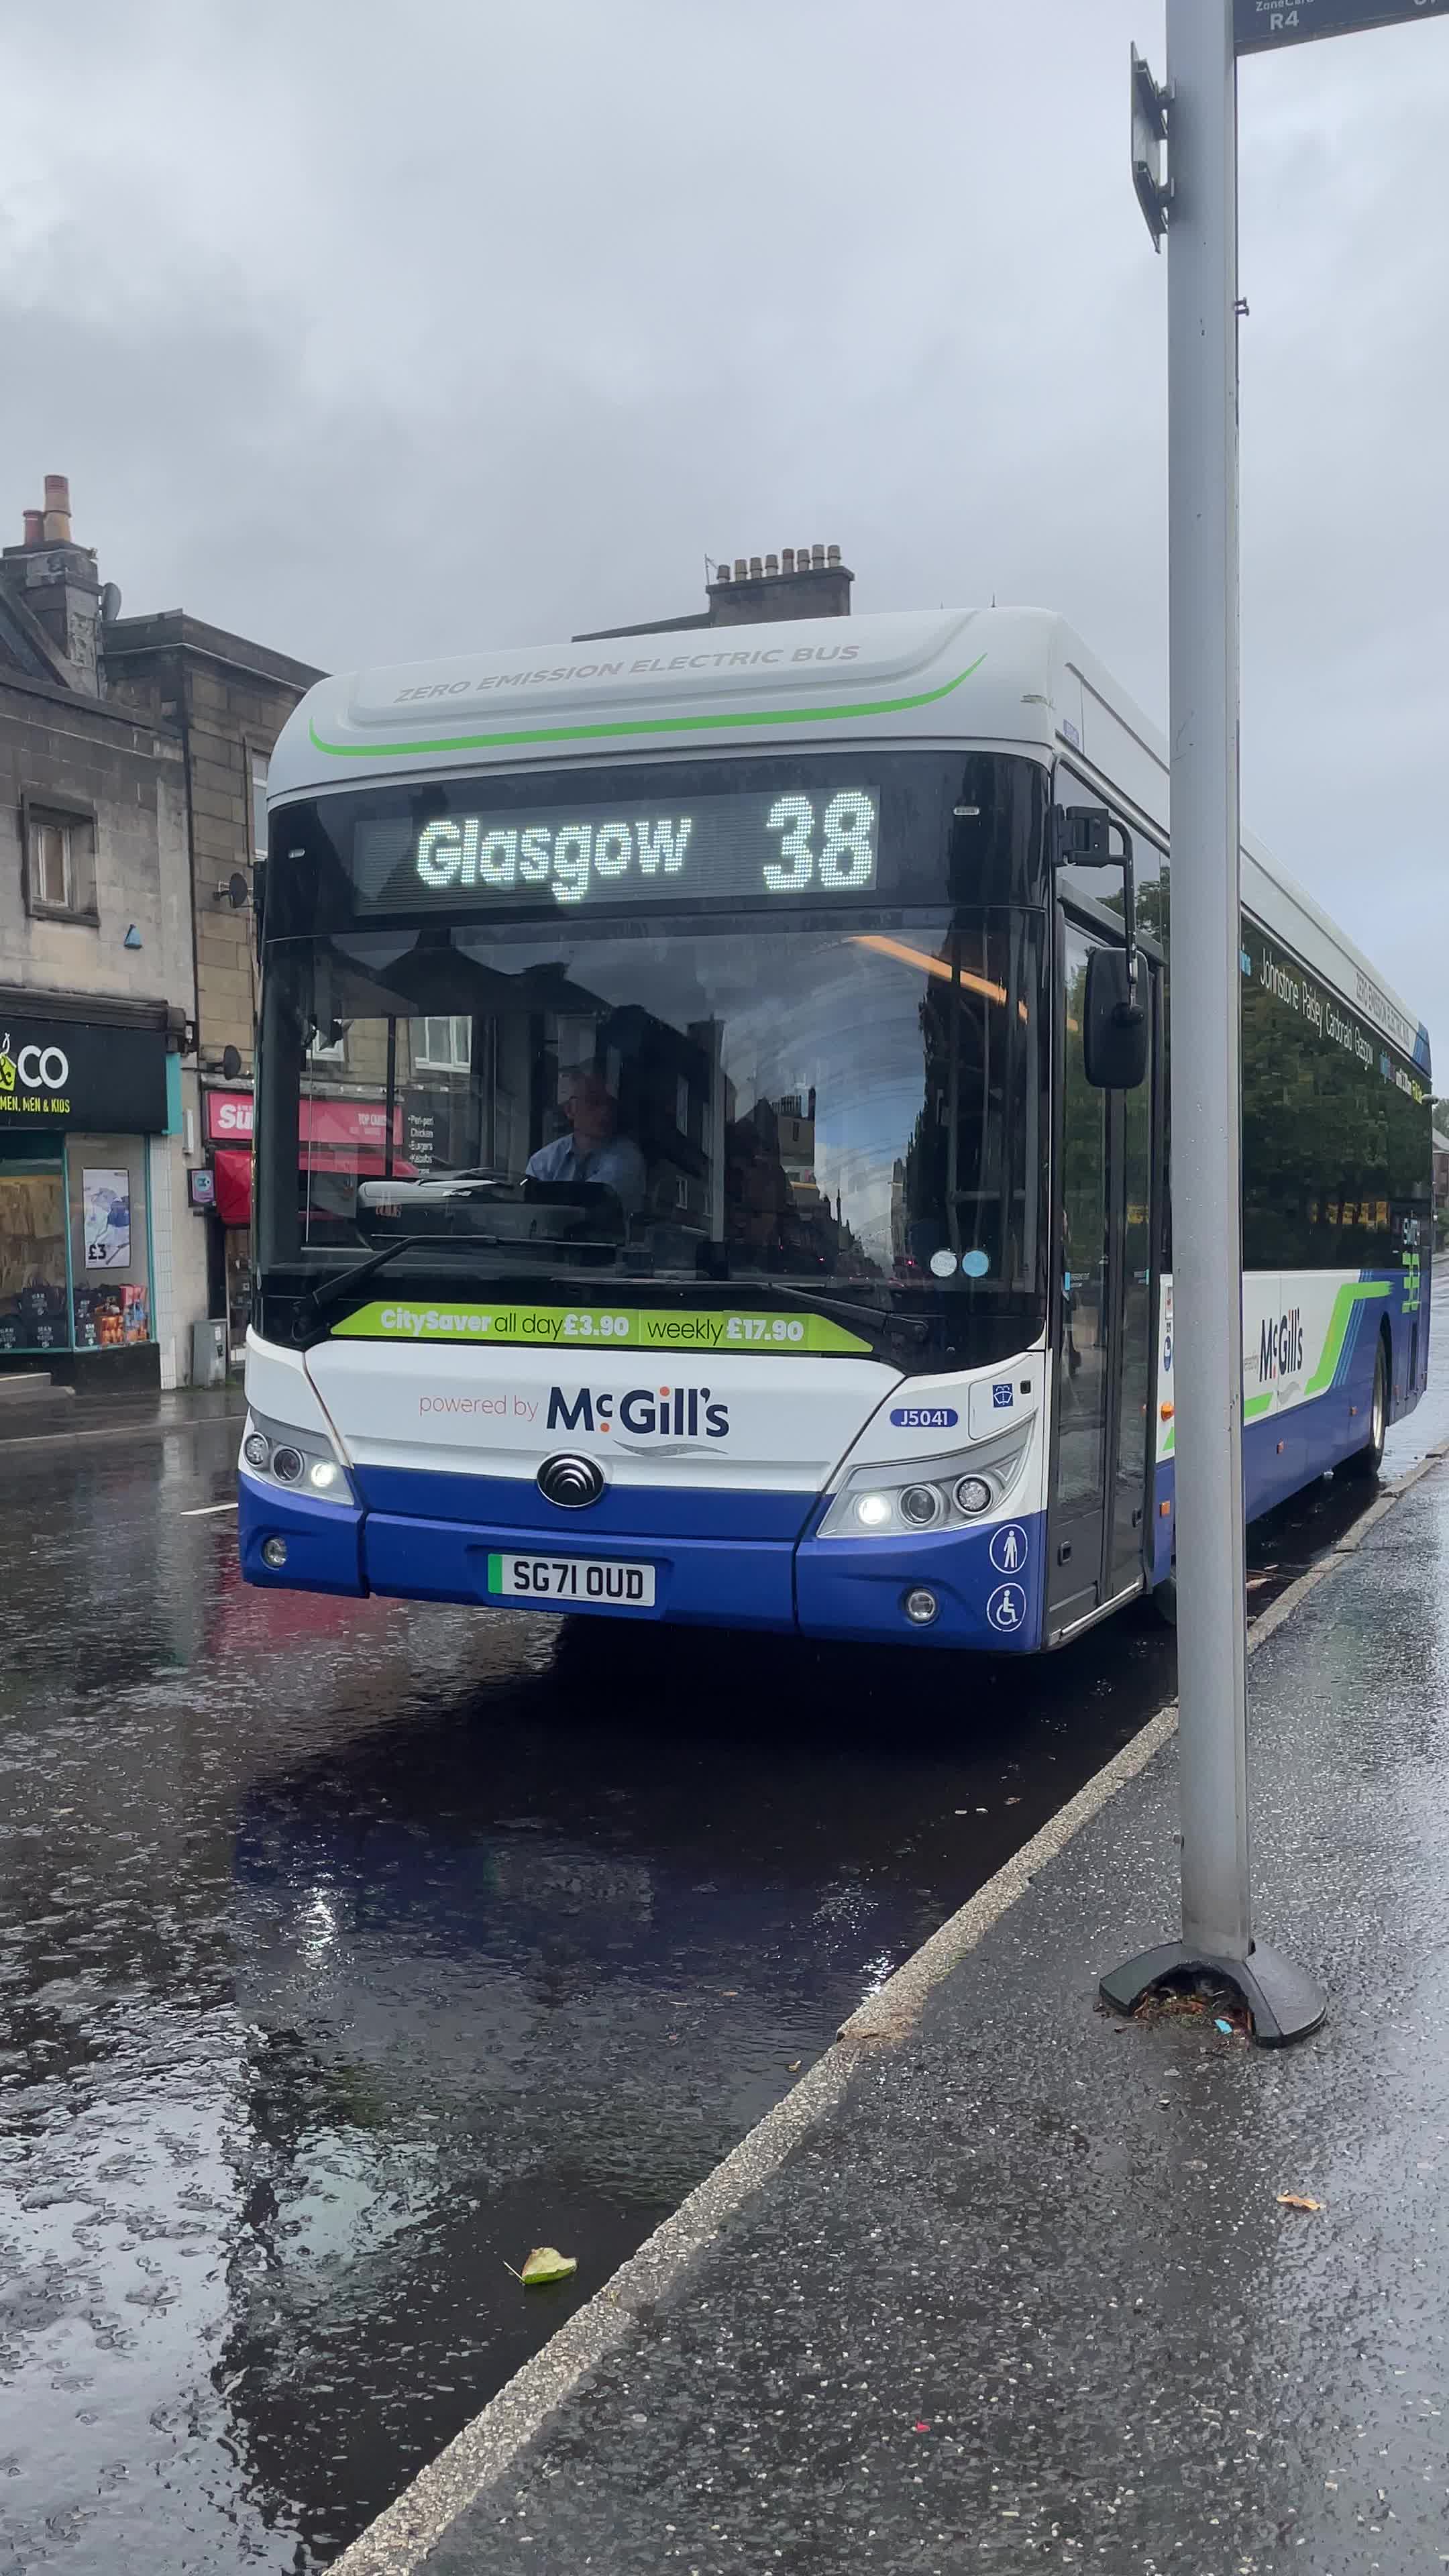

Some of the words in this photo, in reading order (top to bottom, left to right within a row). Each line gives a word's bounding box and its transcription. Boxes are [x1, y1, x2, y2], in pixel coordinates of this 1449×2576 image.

[1255, 0, 1312, 11] ZoneCar
[1270, 11, 1299, 30] R4
[394, 682, 471, 704] ZERO
[476, 661, 622, 692] EMISSION
[629, 648, 785, 674] ELECTRIC
[790, 645, 861, 663] BUS
[417, 818, 692, 903] Glasgow
[762, 791, 875, 890] 38
[1260, 947, 1299, 1010] Johnstone
[1301, 981, 1324, 1038] Paisley
[17, 1044, 69, 1089] CO
[0, 1095, 21, 1112] MEN,
[23, 1096, 40, 1112] MEN
[43, 1099, 49, 1113] &
[51, 1098, 70, 1114] KIDS
[88, 1244, 106, 1260] £3
[380, 1307, 492, 1336] CitySaver
[494, 1312, 516, 1333] all
[521, 1313, 563, 1341] day
[563, 1313, 630, 1336] £3.90
[647, 1318, 724, 1346] weekly
[726, 1317, 804, 1342] £17.90
[1259, 1306, 1303, 1383] McGill's
[419, 1395, 507, 1417] powered
[514, 1395, 539, 1422] by
[546, 1386, 729, 1438] McGill's
[900, 1410, 948, 1426] J5041
[514, 1560, 578, 1595] SG71
[586, 1566, 643, 1599] OUD
